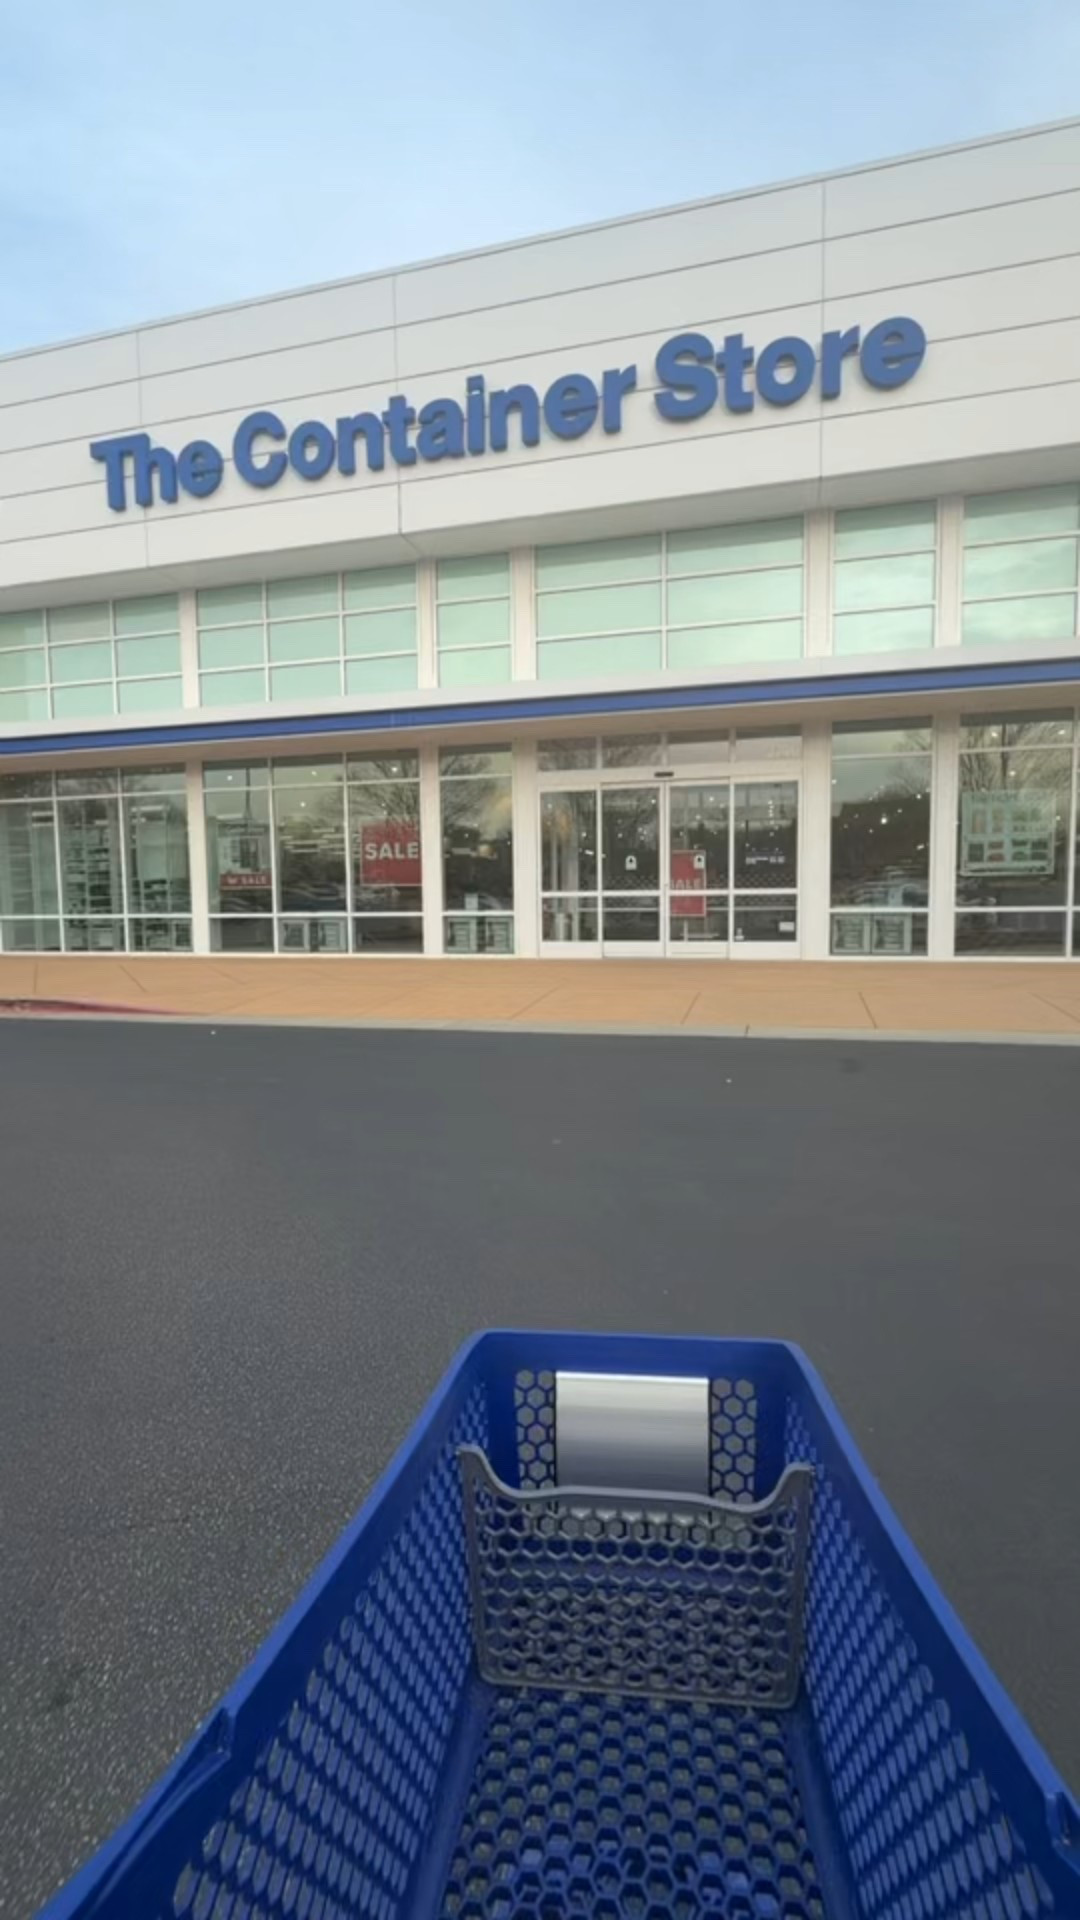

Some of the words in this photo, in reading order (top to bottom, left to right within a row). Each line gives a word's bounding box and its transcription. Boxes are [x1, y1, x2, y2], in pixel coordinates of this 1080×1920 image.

[91, 432, 223, 511] The
[234, 364, 637, 486] Container
[655, 316, 926, 418] Store
[365, 842, 419, 860] SALE
